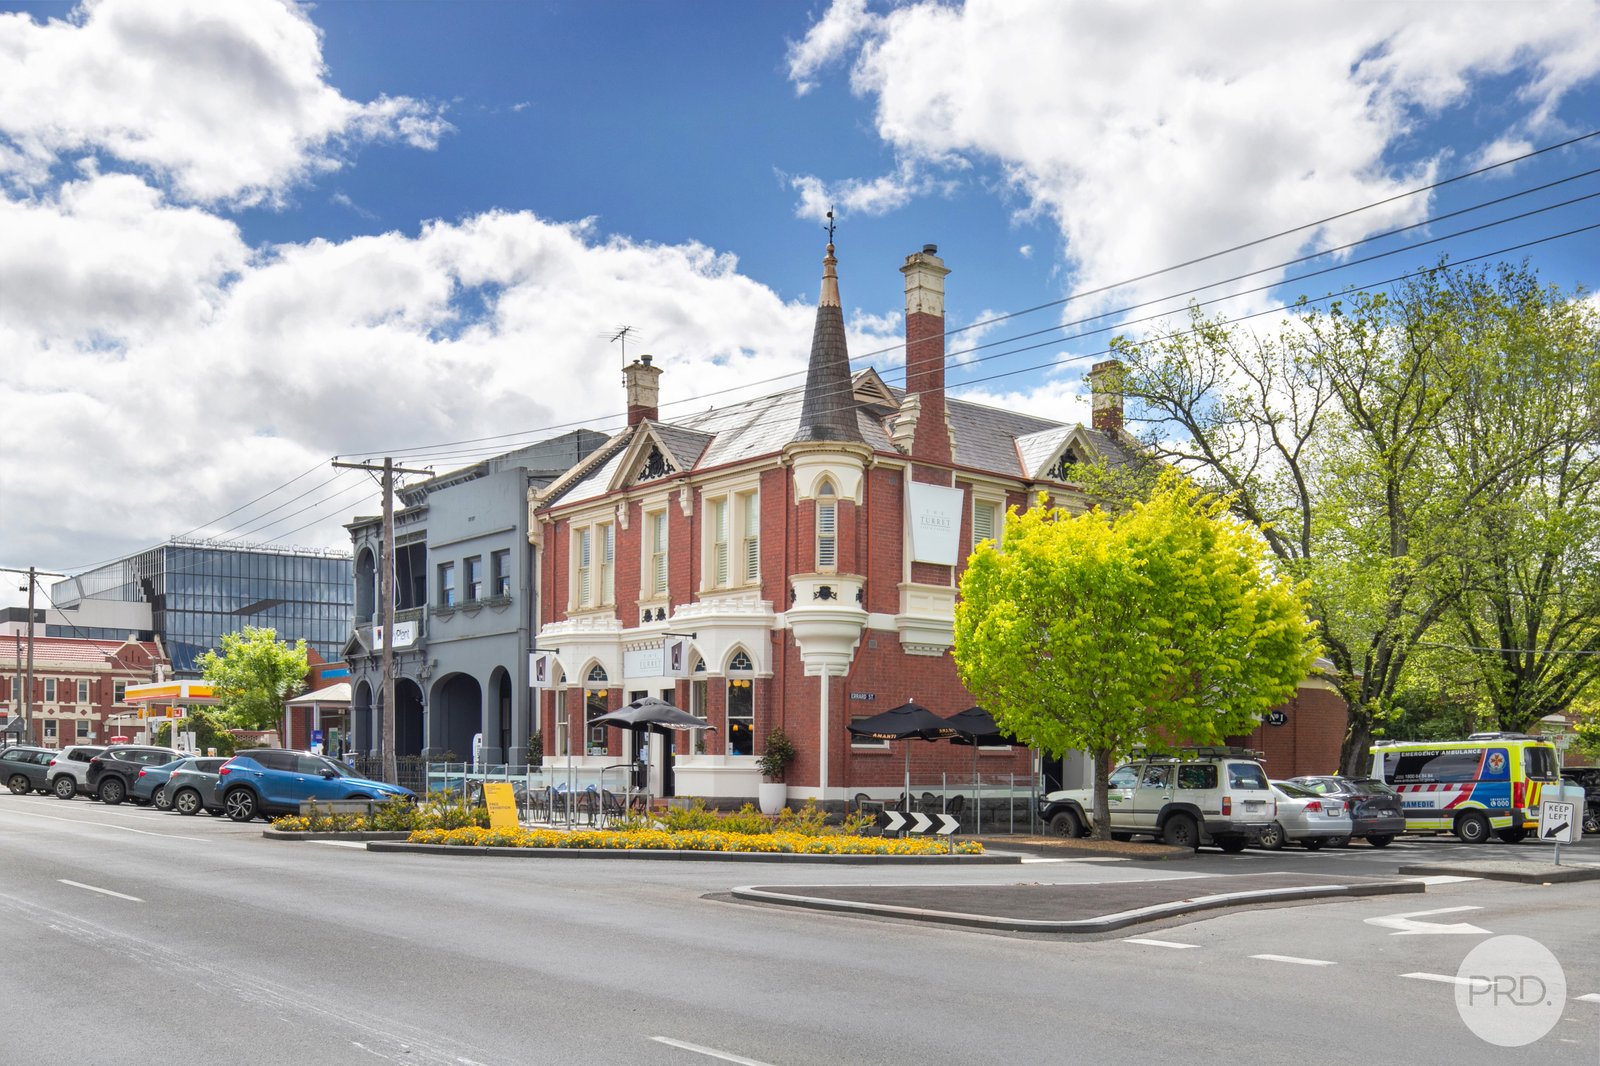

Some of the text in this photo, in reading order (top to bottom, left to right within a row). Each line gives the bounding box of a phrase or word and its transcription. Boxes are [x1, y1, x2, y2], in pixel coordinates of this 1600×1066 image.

[920, 516, 951, 527] TURRET
[206, 537, 245, 549] Regional
[292, 543, 321, 554] Cancer
[868, 693, 874, 701] ST
[872, 732, 897, 740] AMANTI
[1401, 748, 1481, 758] EMERGENCY AMBULANCE
[1401, 800, 1435, 808] RAMEDIC
[1549, 804, 1569, 813] KEEP
[1549, 813, 1568, 821] LEFT
